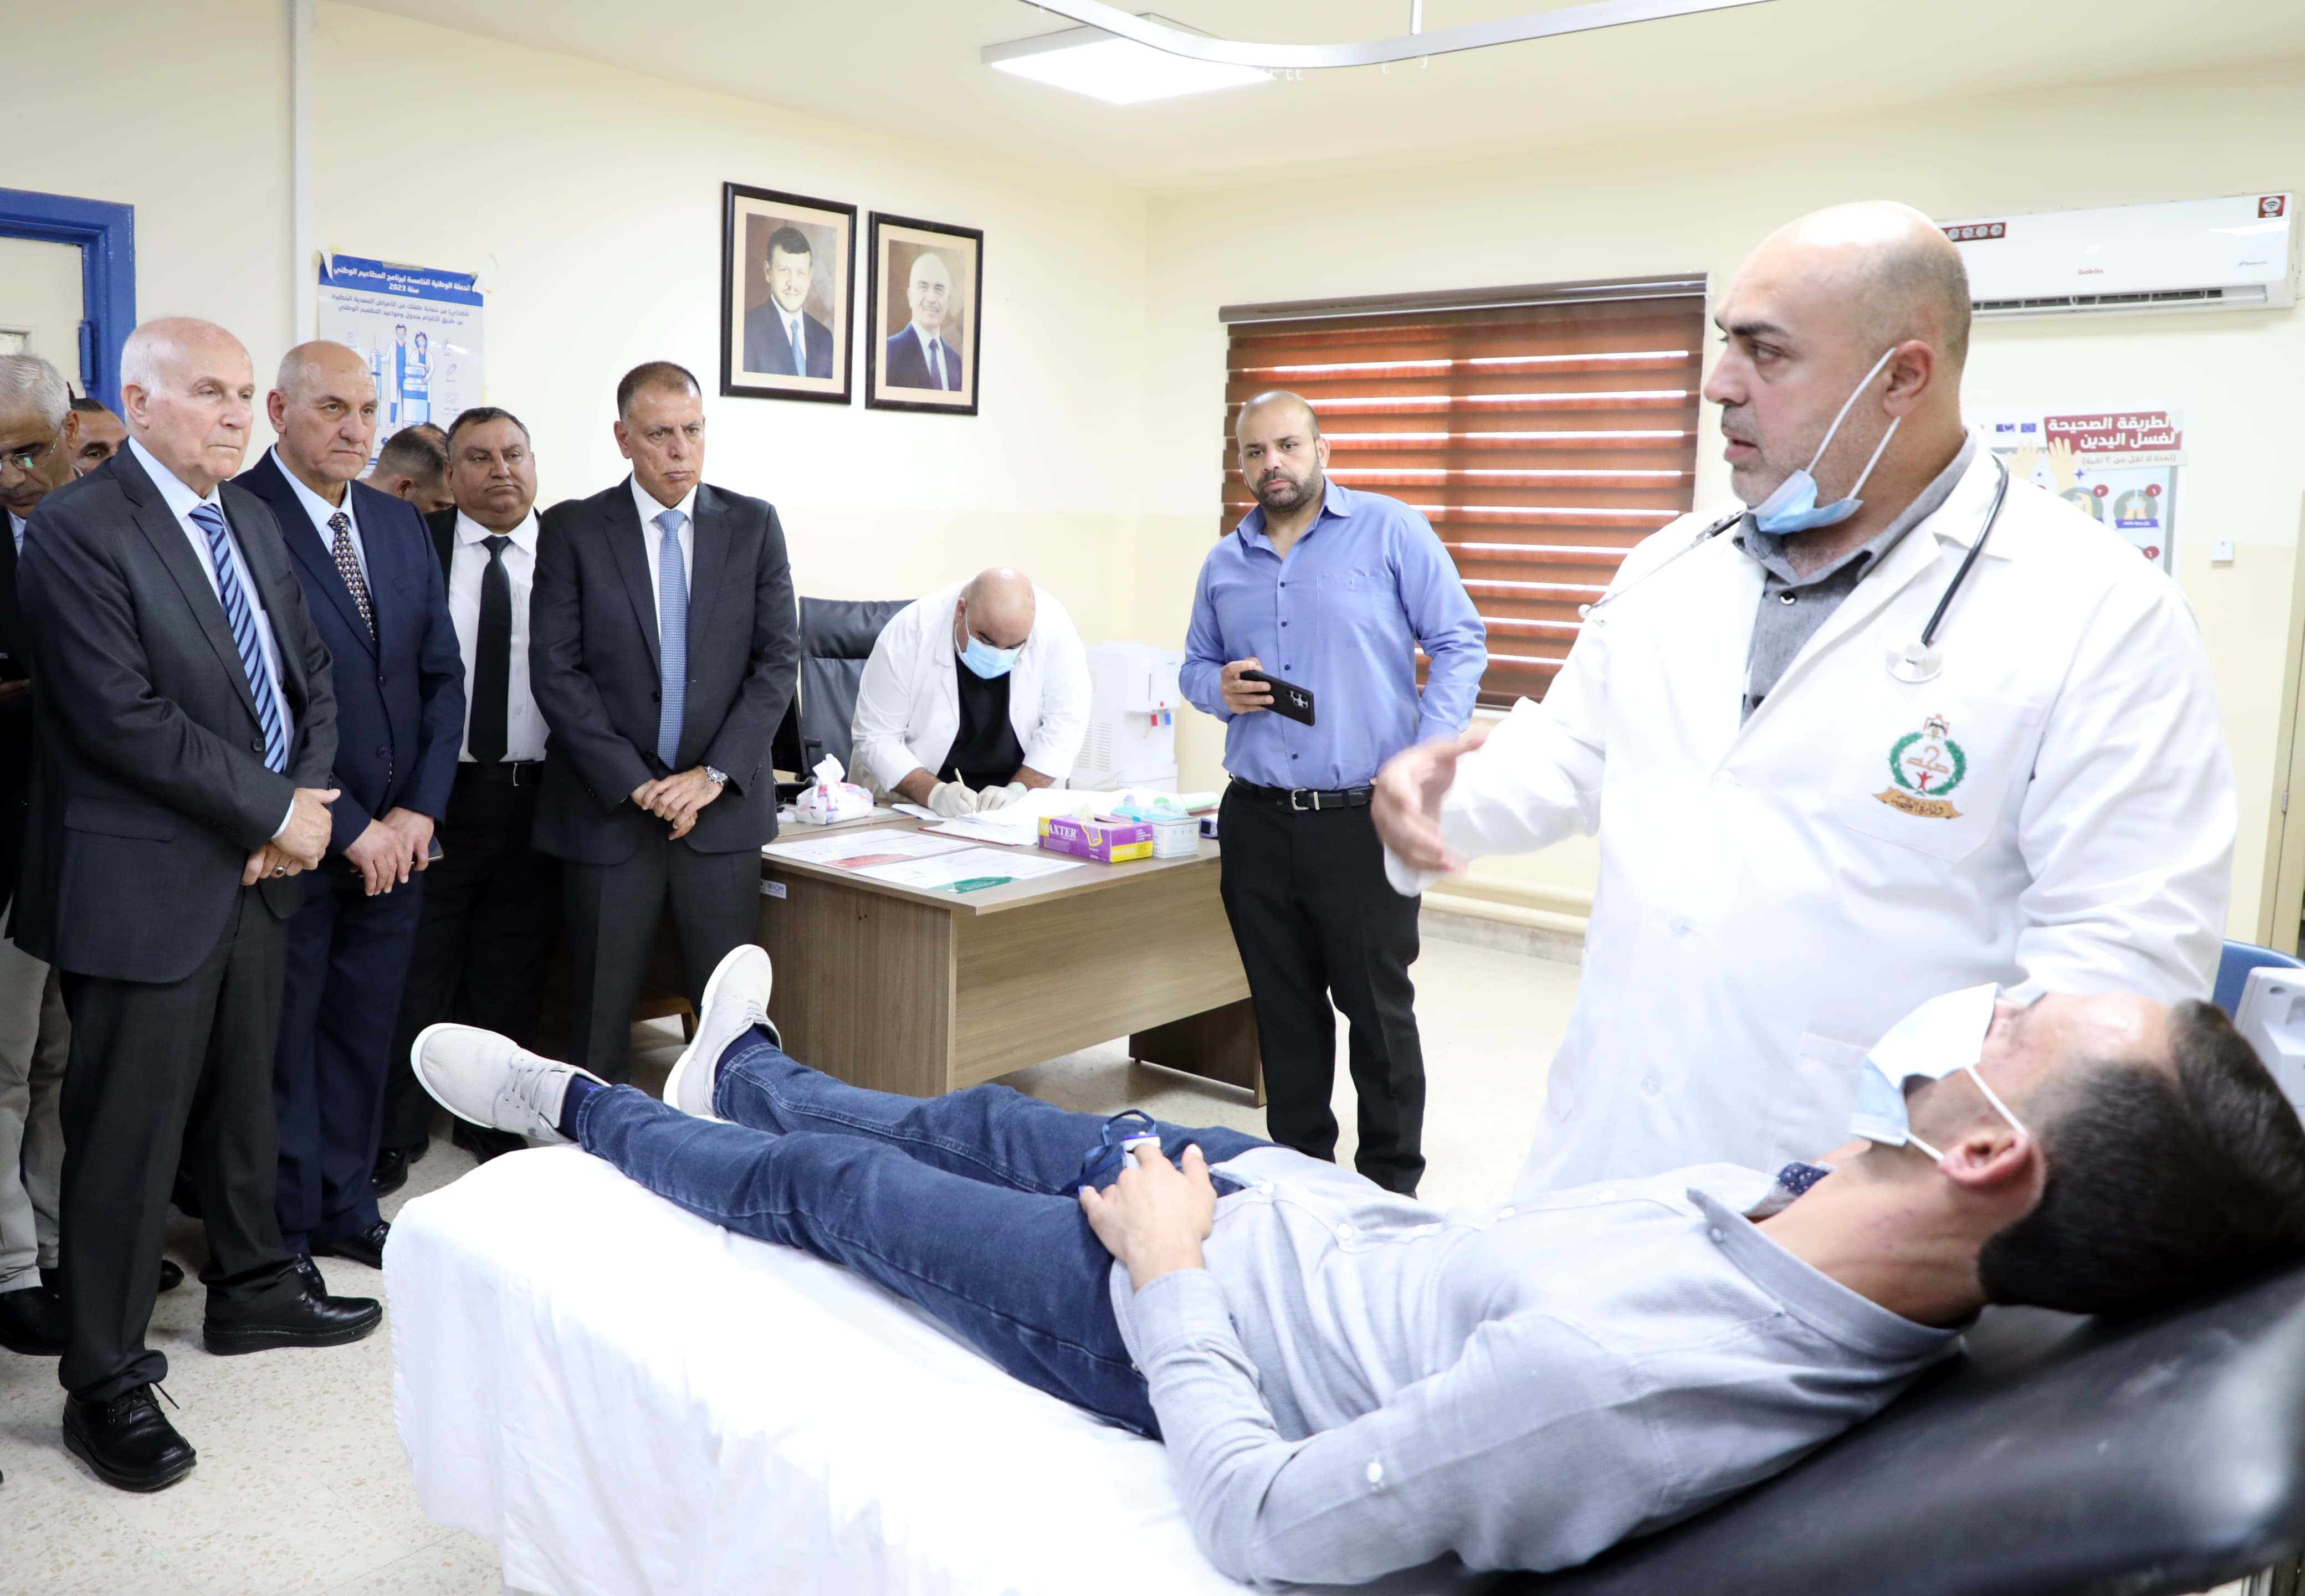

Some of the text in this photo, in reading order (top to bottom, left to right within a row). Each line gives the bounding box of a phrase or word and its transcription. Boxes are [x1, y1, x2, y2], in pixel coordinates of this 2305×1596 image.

[333, 266, 471, 291] الحملة الوطنية الخامسة لبرنامج المطاعيم الوطني
[388, 283, 406, 292] 2023
[2047, 415, 2170, 433] لطريقة الصحيحة
[2079, 432, 2175, 449] لغسل اليدين
